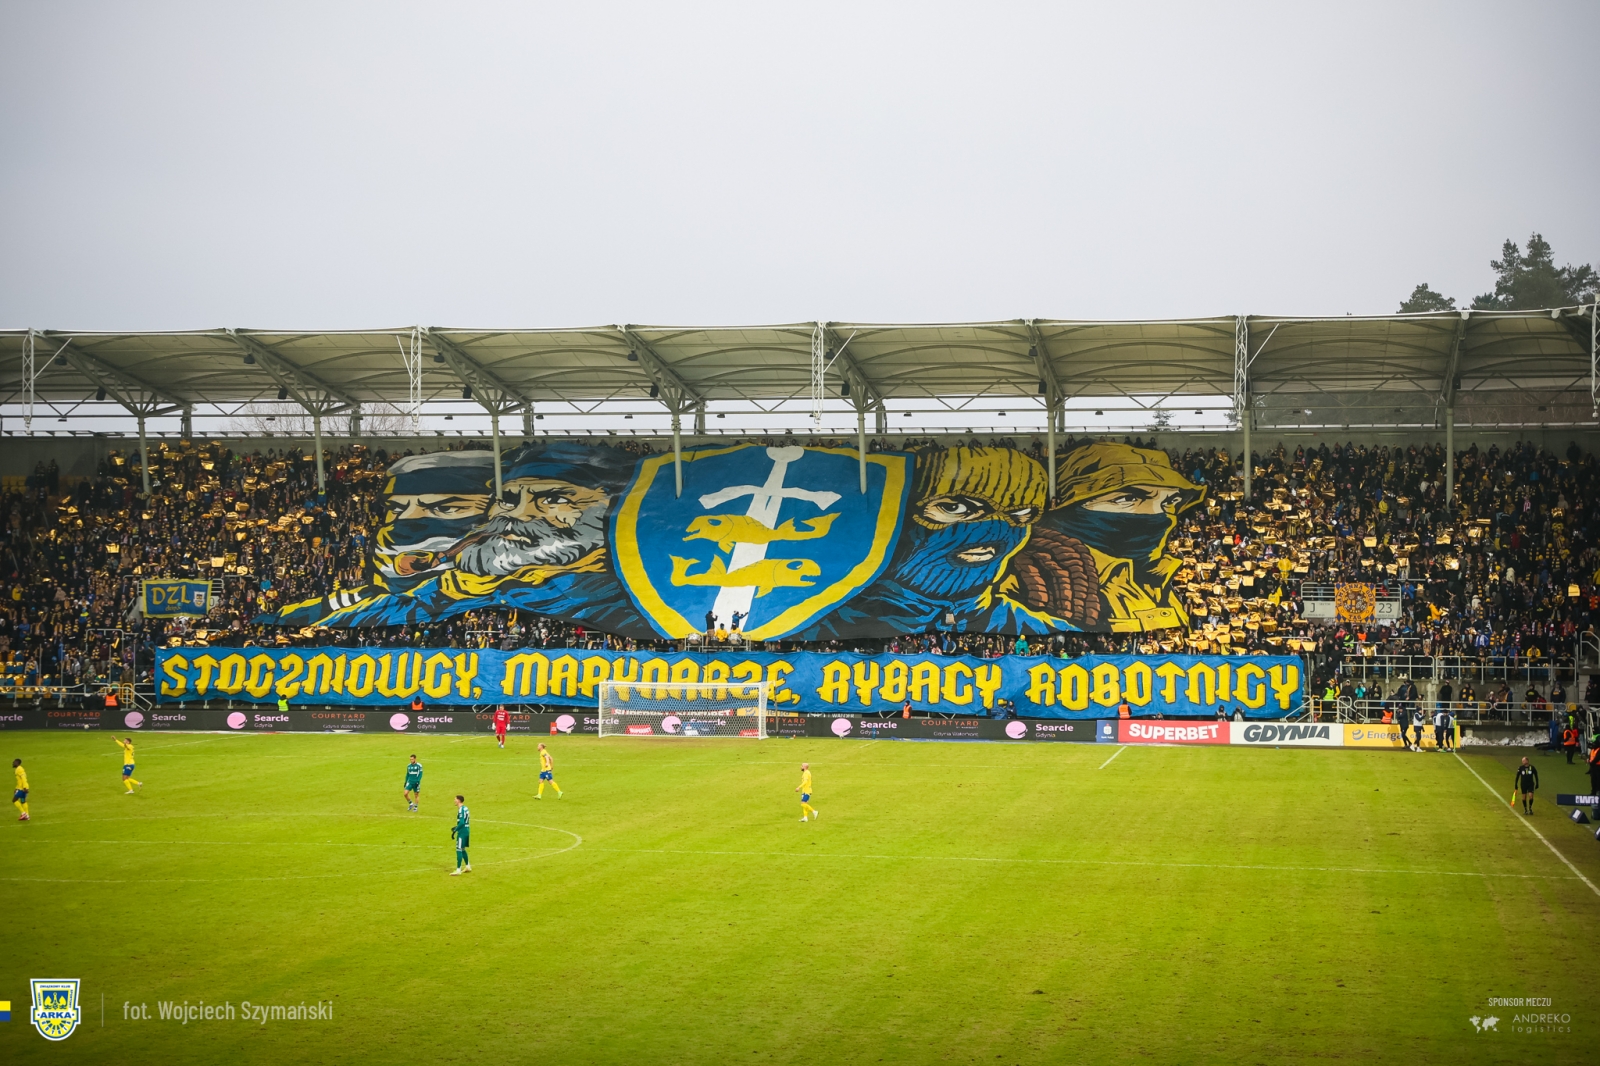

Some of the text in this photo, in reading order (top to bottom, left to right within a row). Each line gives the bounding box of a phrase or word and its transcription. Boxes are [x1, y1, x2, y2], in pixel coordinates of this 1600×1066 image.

[151, 585, 191, 605] DZL
[1378, 602, 1393, 613] 23
[160, 651, 482, 700] STOCZNIOWCY,
[1025, 660, 1300, 711] ROBOTNICY
[417, 715, 453, 723] Searcle
[860, 720, 897, 729] Searcle
[921, 719, 979, 727] COURTYARD
[1035, 723, 1074, 732] Searcle
[1128, 723, 1219, 740] SUPERBET
[1243, 724, 1330, 742] GDYNIA
[1367, 731, 1403, 742] Energa
